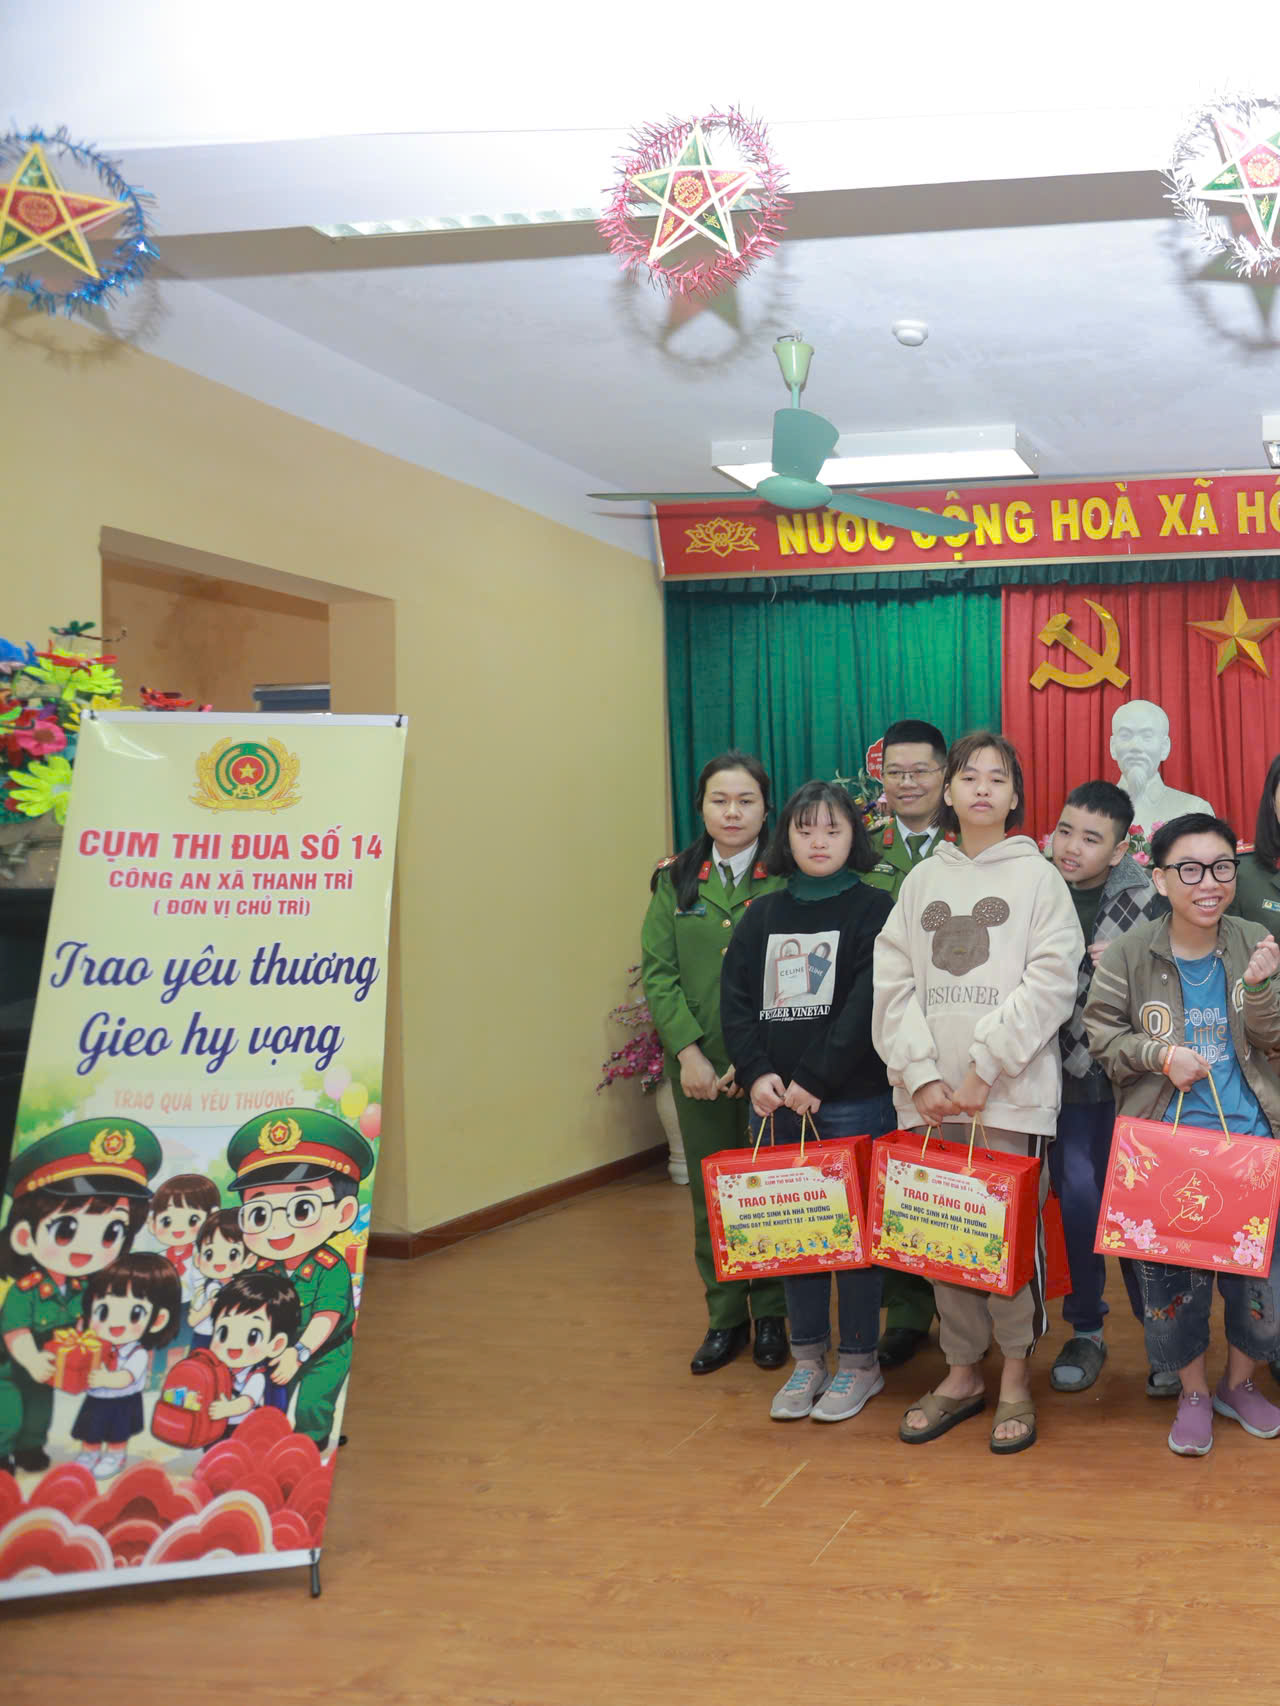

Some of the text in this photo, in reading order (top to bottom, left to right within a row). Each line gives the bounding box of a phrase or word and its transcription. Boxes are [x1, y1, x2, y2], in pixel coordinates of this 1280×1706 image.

[1051, 482, 1141, 541] HOÀ
[1159, 478, 1219, 537] XÃ
[79, 824, 382, 863] CỤM THI ĐUA SỐ 14
[109, 868, 354, 890] CÔNG AN XÃ THANH TRÌ
[167, 898, 206, 916] ĐƠN
[213, 899, 230, 919] VỊ
[236, 894, 272, 916] CHỦ
[277, 897, 311, 916] TRÌ)
[50, 940, 381, 1004] Trao yêu thương
[780, 966, 805, 977] CELINE
[927, 985, 1000, 1007] ESIGNER
[76, 1011, 344, 1076] Gieo hy vọng
[1184, 1023, 1228, 1044] ittle
[1192, 1043, 1230, 1065] UDE
[114, 1088, 153, 1110] TRAO
[738, 1196, 767, 1208] TRAO
[769, 1191, 801, 1207] TẶNG
[903, 1187, 929, 1202] TRAO
[932, 1193, 961, 1211] TẶNG
